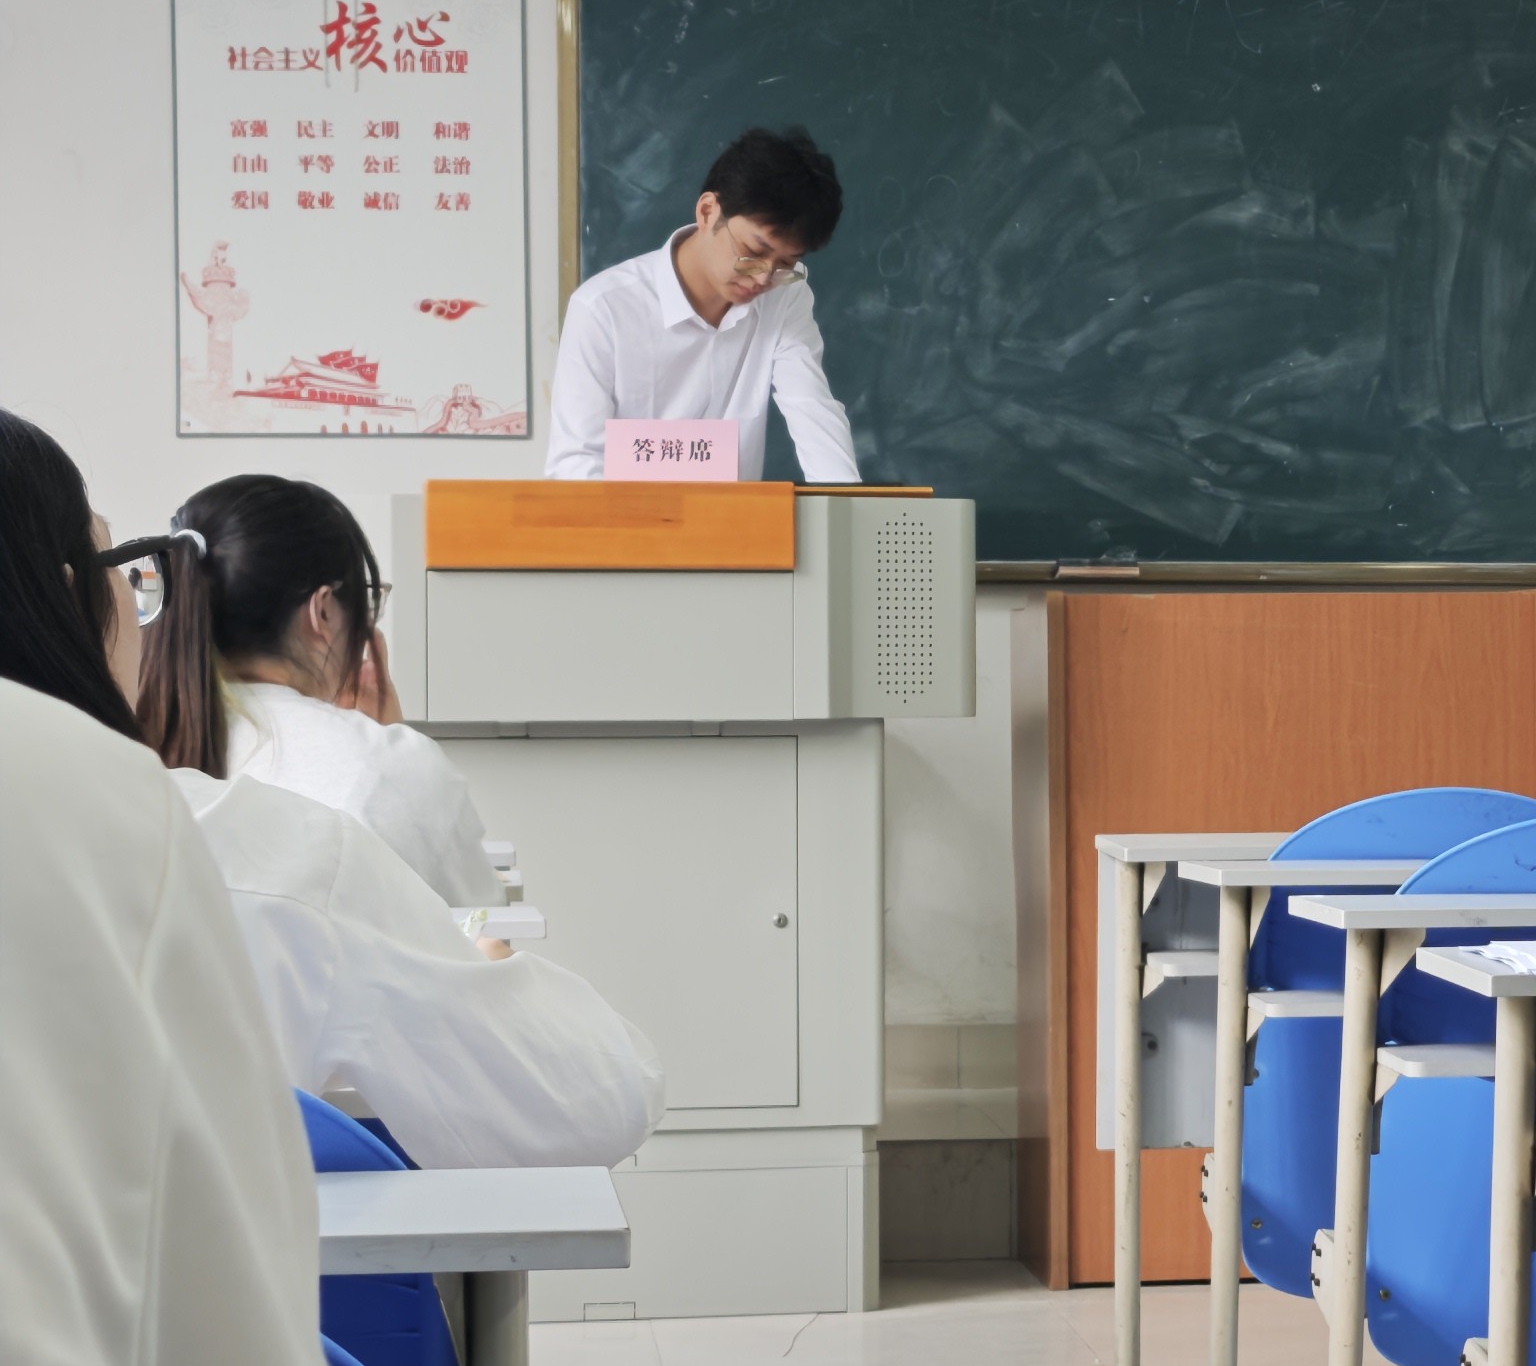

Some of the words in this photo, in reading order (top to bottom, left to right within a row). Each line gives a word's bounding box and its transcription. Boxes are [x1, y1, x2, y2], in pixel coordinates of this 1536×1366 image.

[228, 46, 324, 71] 社会主义
[320, 0, 450, 73] 核心
[393, 48, 468, 73] 价值观
[230, 119, 268, 138] 富强
[297, 120, 334, 138] 民主
[363, 120, 399, 139] 文明
[433, 121, 470, 140] 和谐
[233, 153, 268, 173] 自由
[299, 154, 334, 173] 平等
[363, 155, 400, 173] 公正
[433, 156, 470, 175] 法治
[231, 190, 269, 209] 爱国
[298, 190, 335, 209] 敬业
[363, 191, 399, 210] 诚信
[435, 191, 471, 211] 友善
[633, 438, 712, 462] 答辩席
